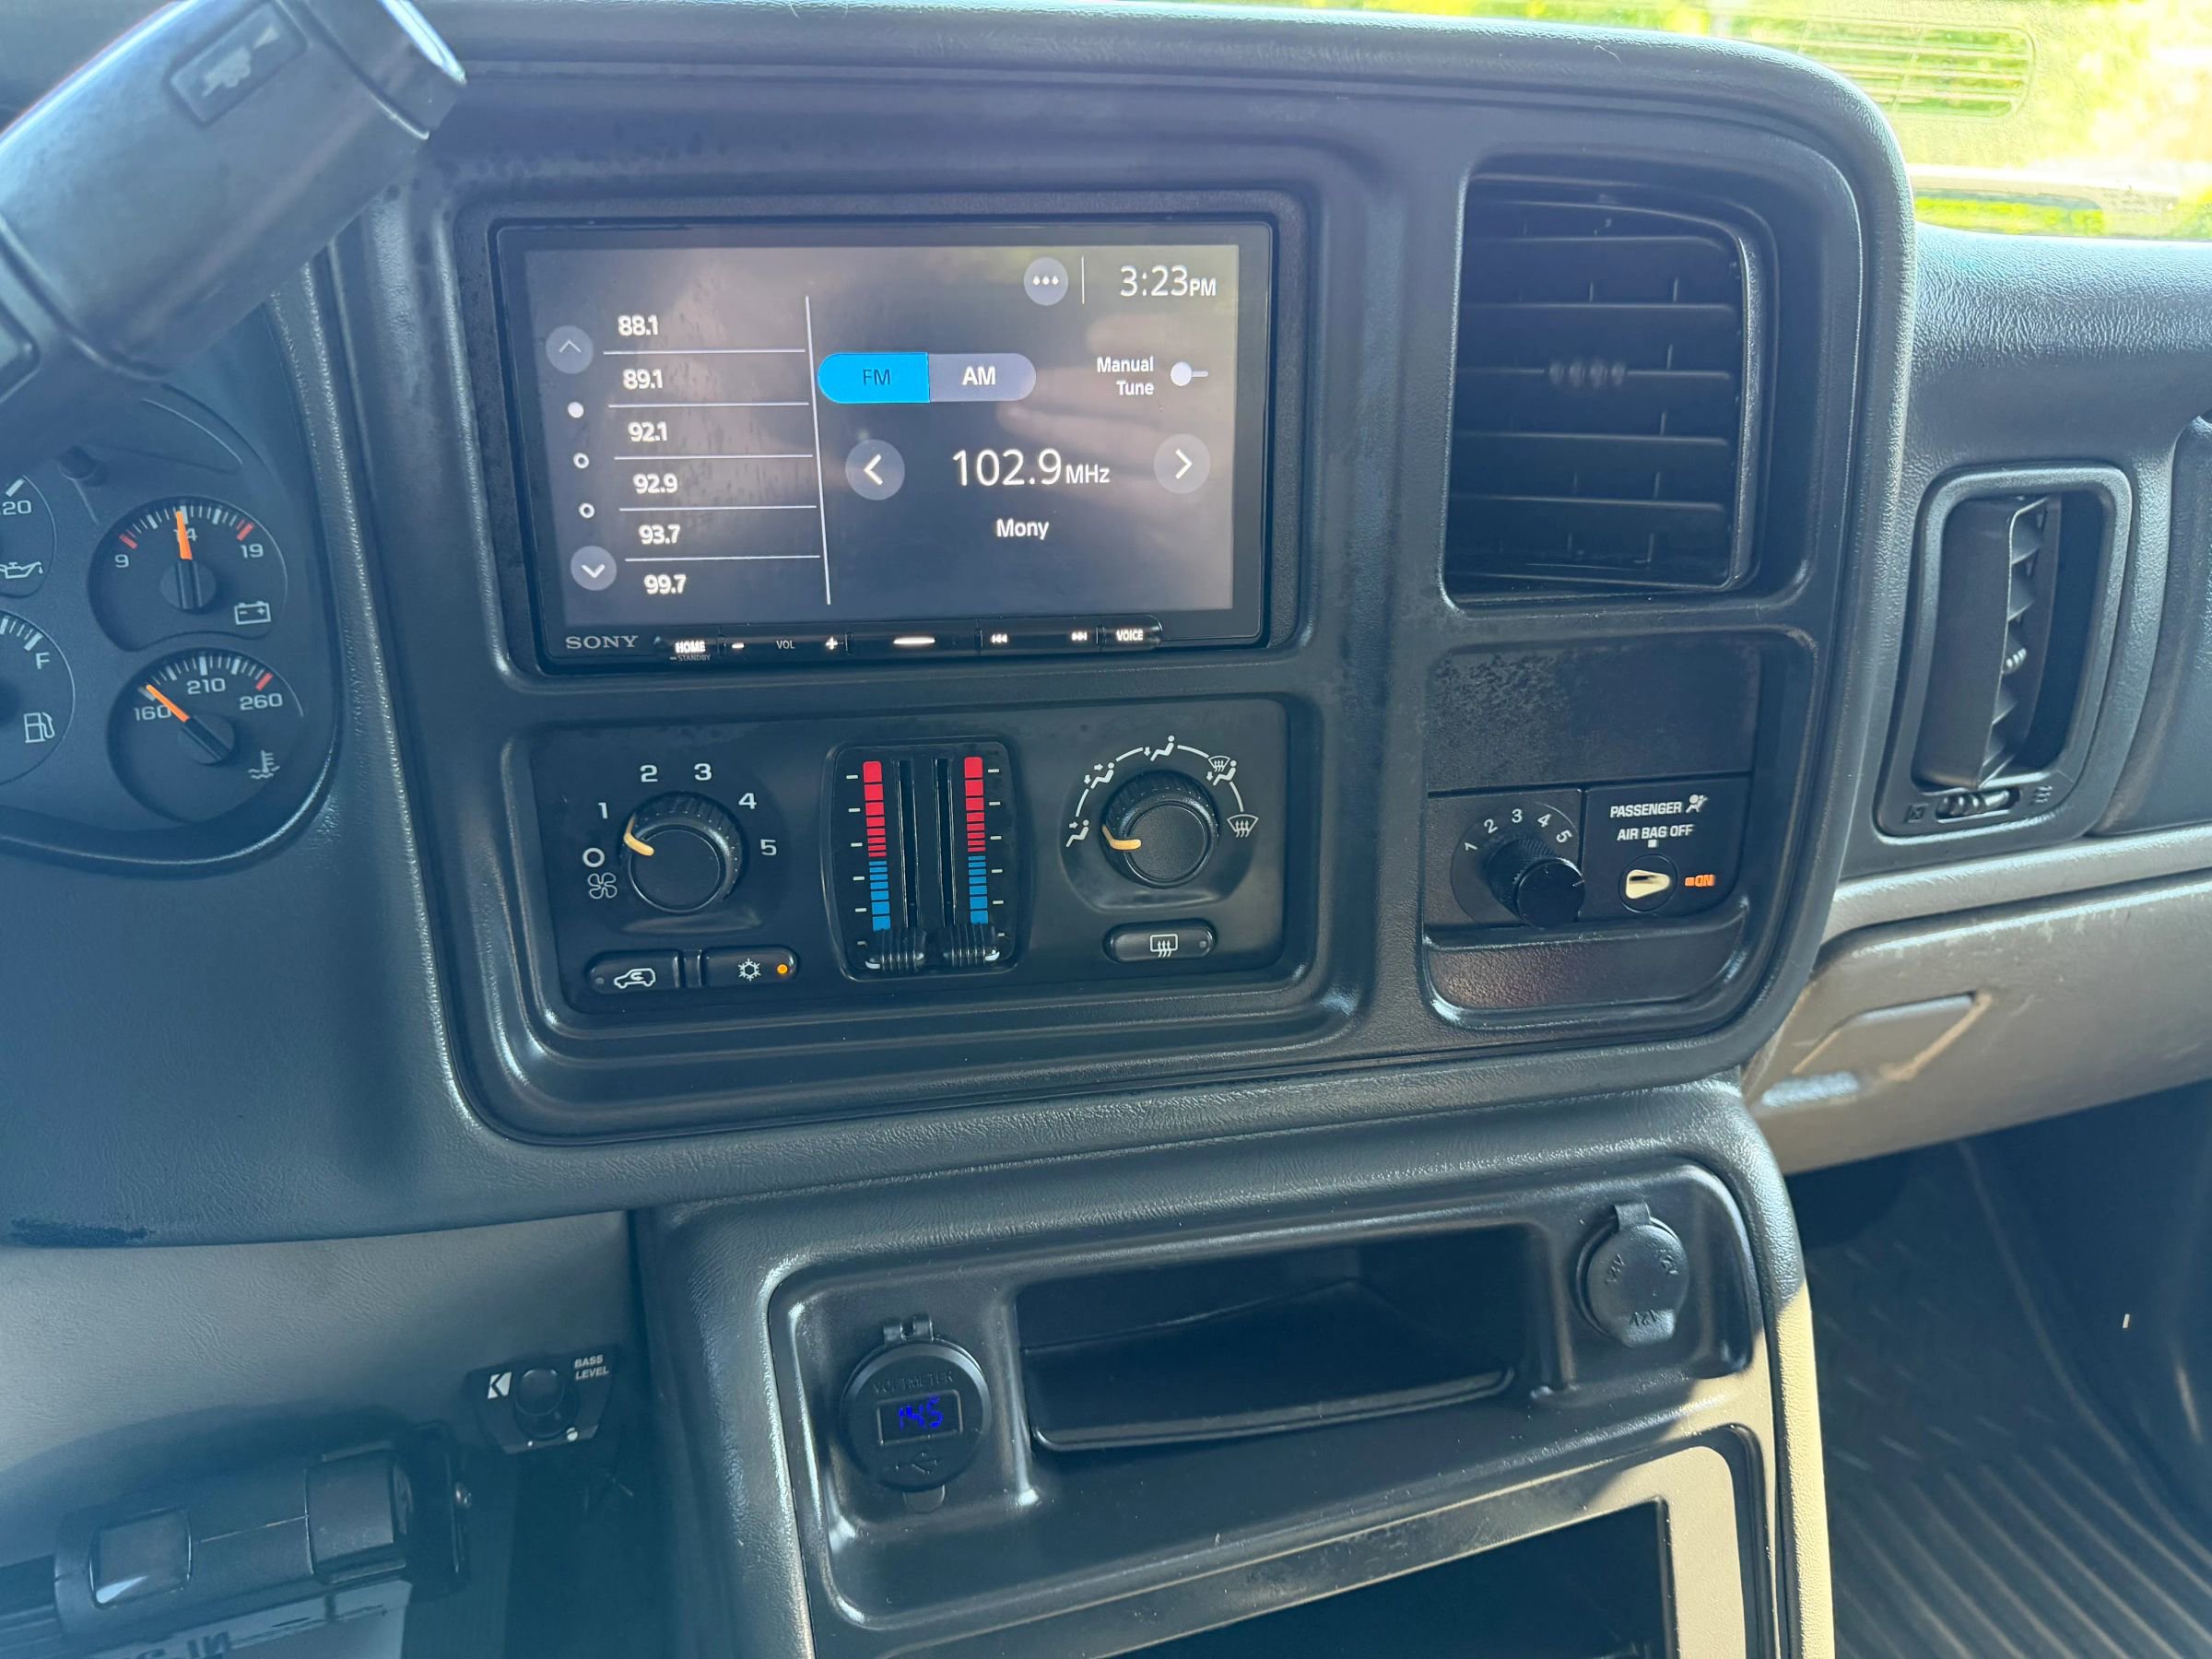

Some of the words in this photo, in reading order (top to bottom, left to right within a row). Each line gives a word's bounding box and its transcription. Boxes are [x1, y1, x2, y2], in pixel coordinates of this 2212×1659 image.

[618, 314, 659, 336] 88.1
[1096, 355, 1154, 373] Manual
[622, 368, 664, 390] 89.1
[862, 369, 891, 386] FM
[961, 365, 996, 386] AM
[1115, 379, 1155, 396] Tune
[627, 421, 668, 442] 92.1
[632, 473, 678, 495] 92.9
[0, 500, 32, 516] 20
[173, 528, 198, 541] 4
[638, 524, 681, 545] 93.7
[995, 518, 1050, 541] Mony
[240, 543, 265, 559] 19
[114, 553, 130, 569] 9
[643, 573, 687, 595] 99.7
[565, 635, 639, 650] SONY
[1115, 628, 1144, 641] VOICE
[675, 640, 706, 654] HOME
[776, 640, 795, 650] VOL
[35, 652, 51, 670] F
[186, 677, 227, 695] 210
[239, 692, 283, 711] 260
[134, 704, 172, 722] 160
[640, 764, 658, 782] 2
[693, 762, 712, 782] 3
[738, 792, 758, 810] 4
[1609, 801, 1683, 818] PASSENGER
[597, 802, 608, 819] 1
[1511, 808, 1524, 824] 3
[1483, 818, 1499, 834] 2
[1537, 813, 1552, 828] 4
[1556, 830, 1573, 843] 5
[1616, 828, 1640, 841] AIR
[1641, 825, 1668, 840] BAG
[1669, 823, 1694, 838] OFF
[759, 839, 777, 856] 5
[1464, 841, 1478, 852] 1
[1693, 874, 1715, 888] ON
[574, 1355, 604, 1368] BASS
[575, 1366, 609, 1381] LEVEL
